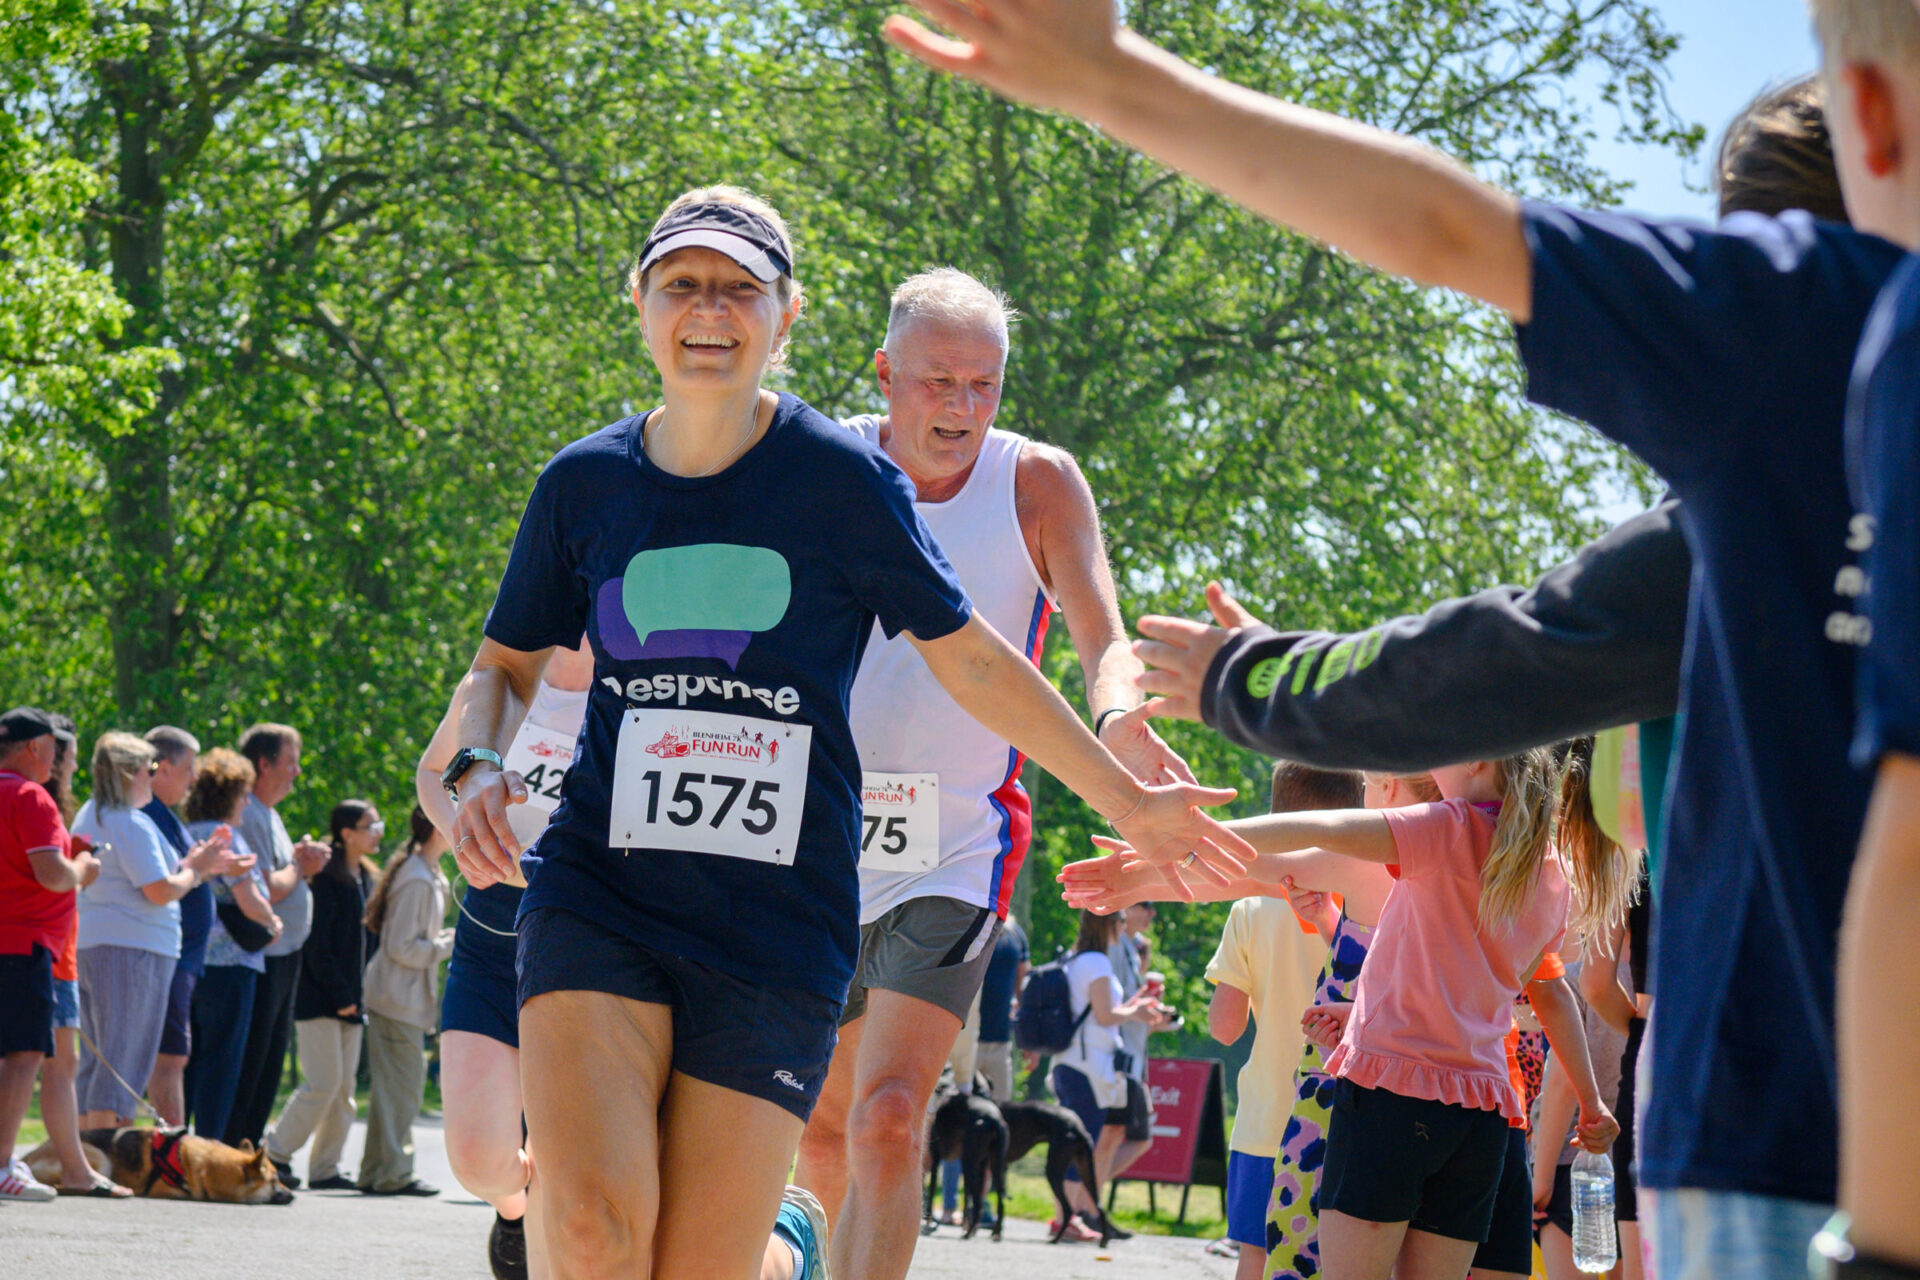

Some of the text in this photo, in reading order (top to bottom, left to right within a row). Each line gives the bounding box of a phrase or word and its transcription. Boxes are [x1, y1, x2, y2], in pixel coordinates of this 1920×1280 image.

[692, 731, 731, 741] BLENHEIM
[692, 739, 724, 753] FUN
[727, 742, 760, 759] RUN
[641, 770, 780, 835] 1575
[878, 791, 903, 802] RUN
[861, 815, 907, 855] 75
